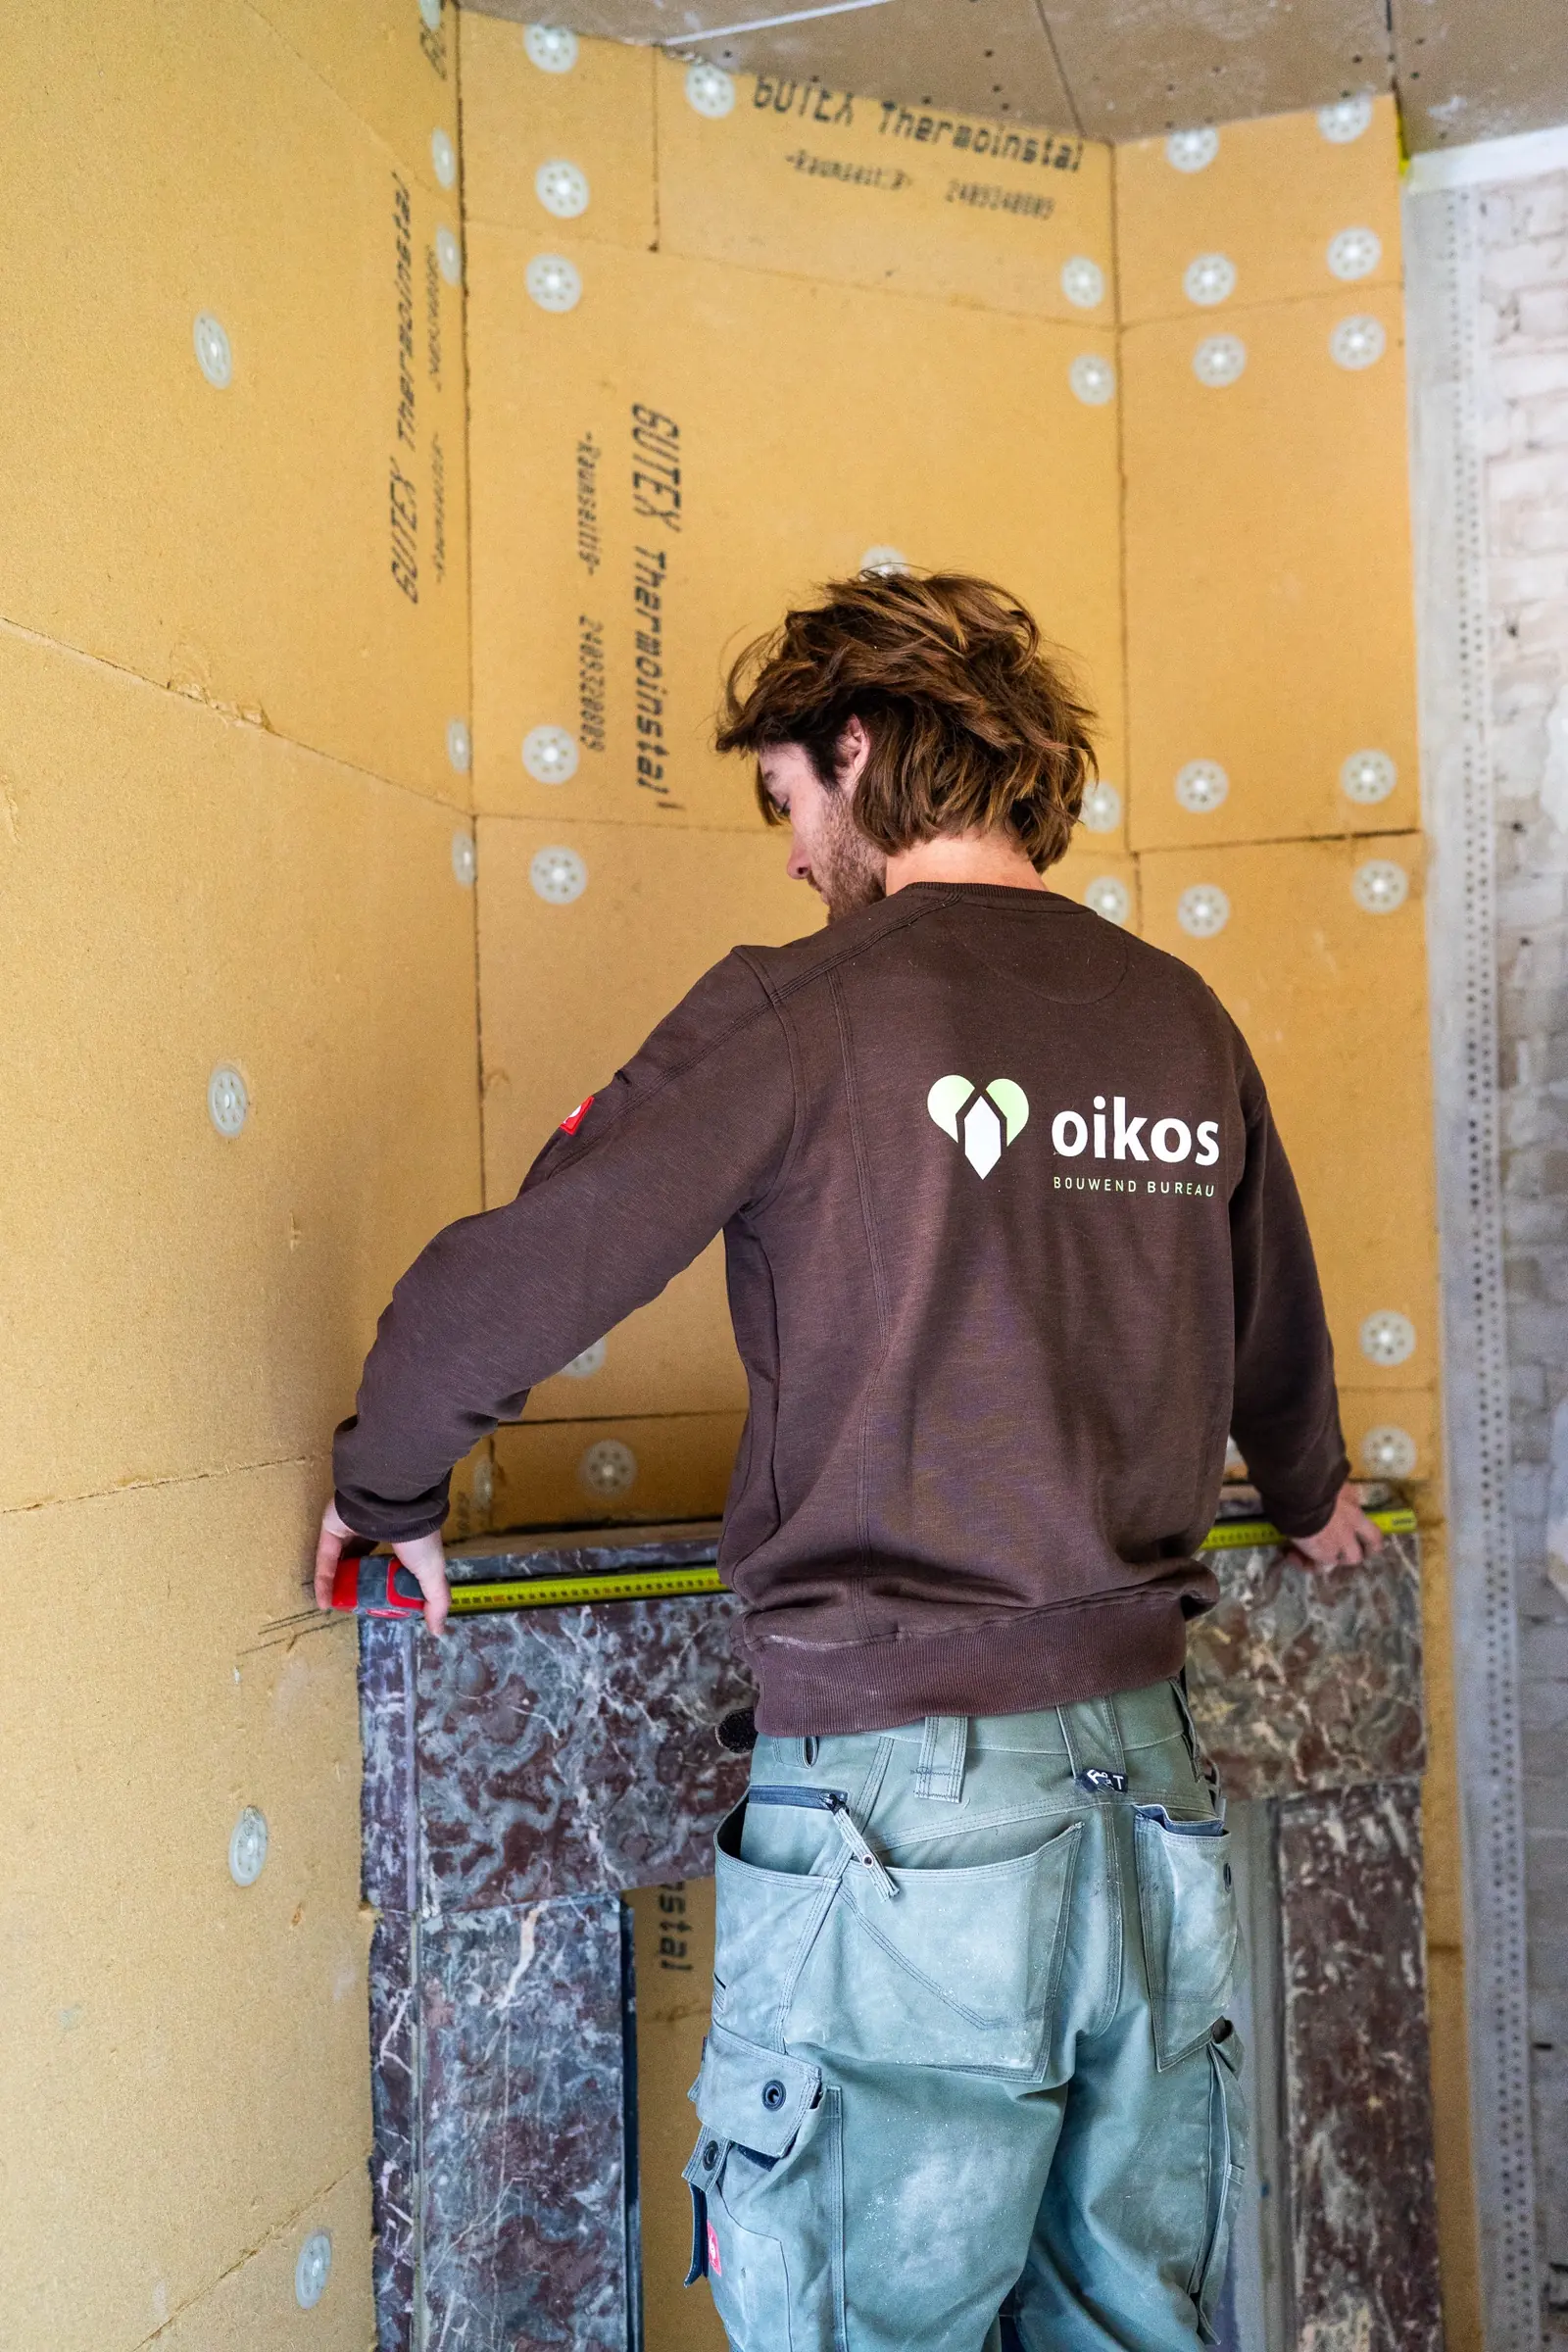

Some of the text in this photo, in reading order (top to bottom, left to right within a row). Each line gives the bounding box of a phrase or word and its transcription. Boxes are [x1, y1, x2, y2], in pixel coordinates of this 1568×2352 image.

[389, 456, 419, 606] GUTEX
[630, 402, 683, 795] GUTEX Thermoinstal
[1051, 1095, 1221, 1166] oikos
[1054, 1176, 1215, 1198] BOUWEND BUREAU
